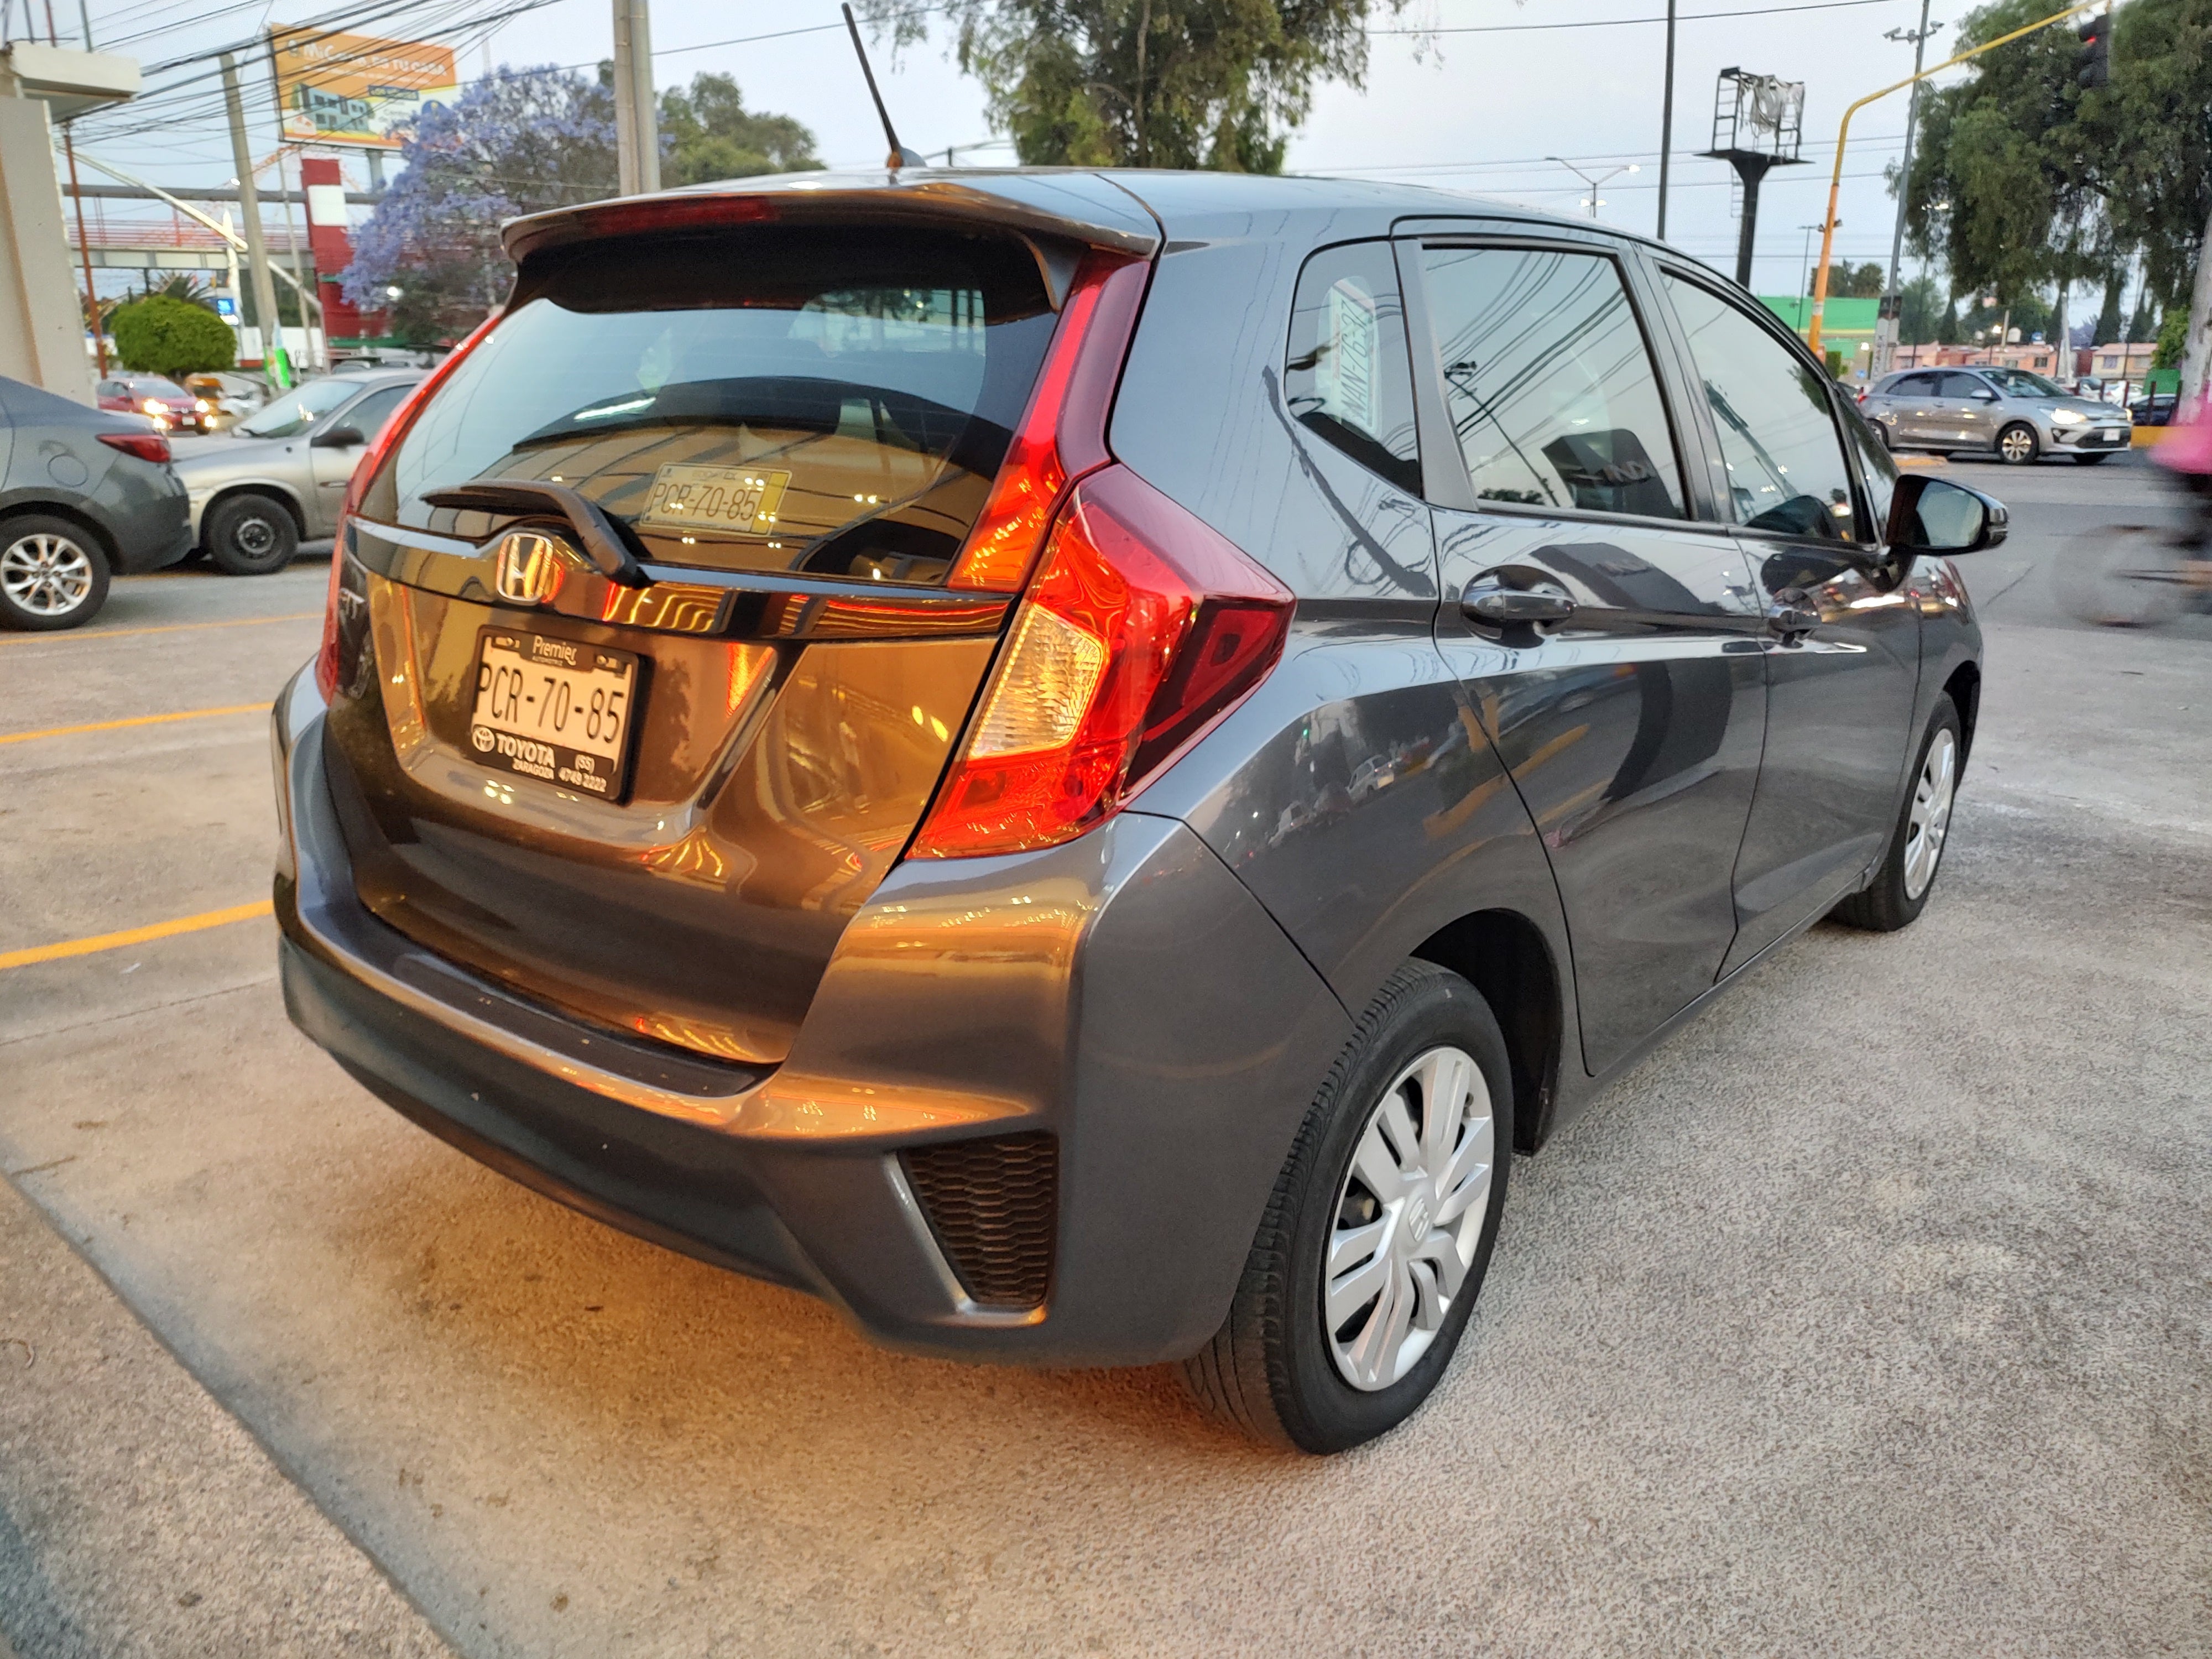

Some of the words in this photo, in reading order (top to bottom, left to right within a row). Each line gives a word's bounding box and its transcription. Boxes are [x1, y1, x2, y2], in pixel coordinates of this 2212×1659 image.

[653, 482, 763, 521] PCR-70-85
[533, 635, 577, 666] Premier
[476, 662, 625, 744] PCR-70-85
[495, 732, 556, 768] TOYOTA
[512, 758, 555, 780] ZARAGOZA
